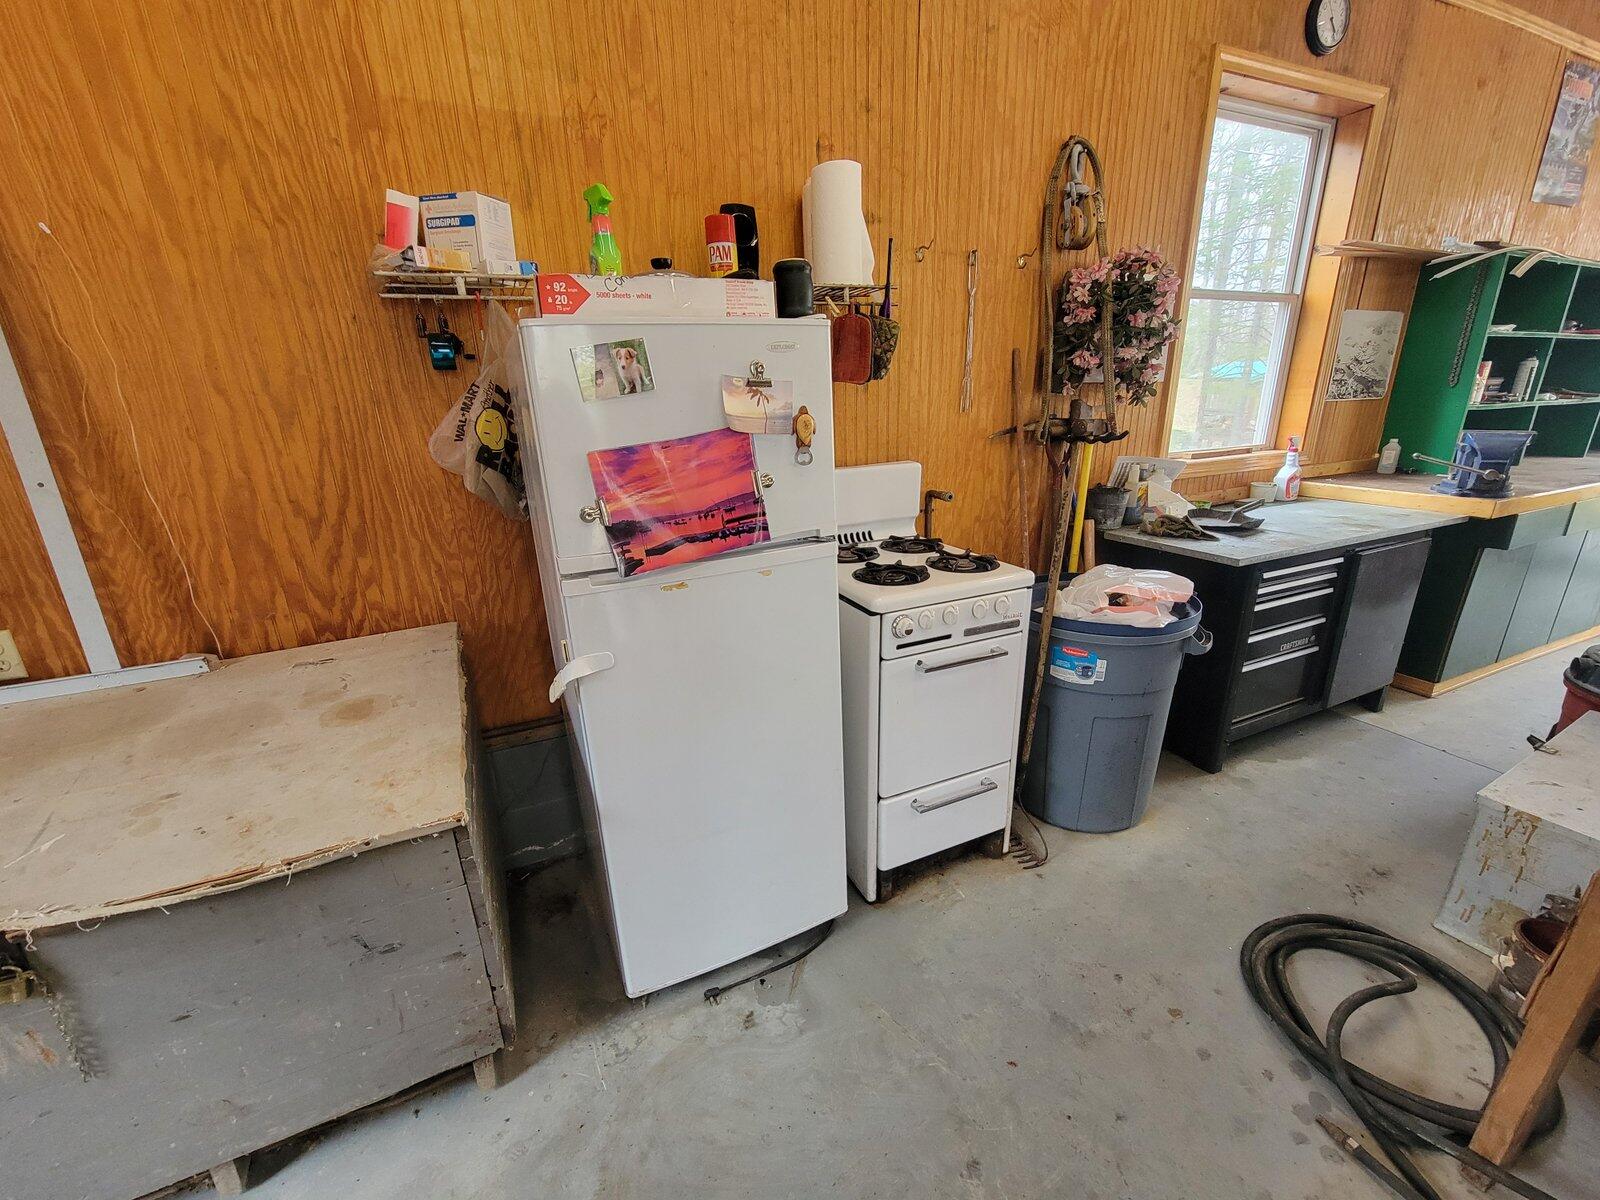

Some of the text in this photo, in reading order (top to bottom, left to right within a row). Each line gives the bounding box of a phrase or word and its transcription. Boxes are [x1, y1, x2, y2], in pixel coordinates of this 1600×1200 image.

[427, 217, 460, 228] SURGIPAD
[709, 244, 732, 262] PAM
[553, 282, 567, 292] 92
[555, 294, 568, 305] 20
[596, 291, 611, 299] 5000
[1280, 636, 1311, 652] CRAFTSMAN
